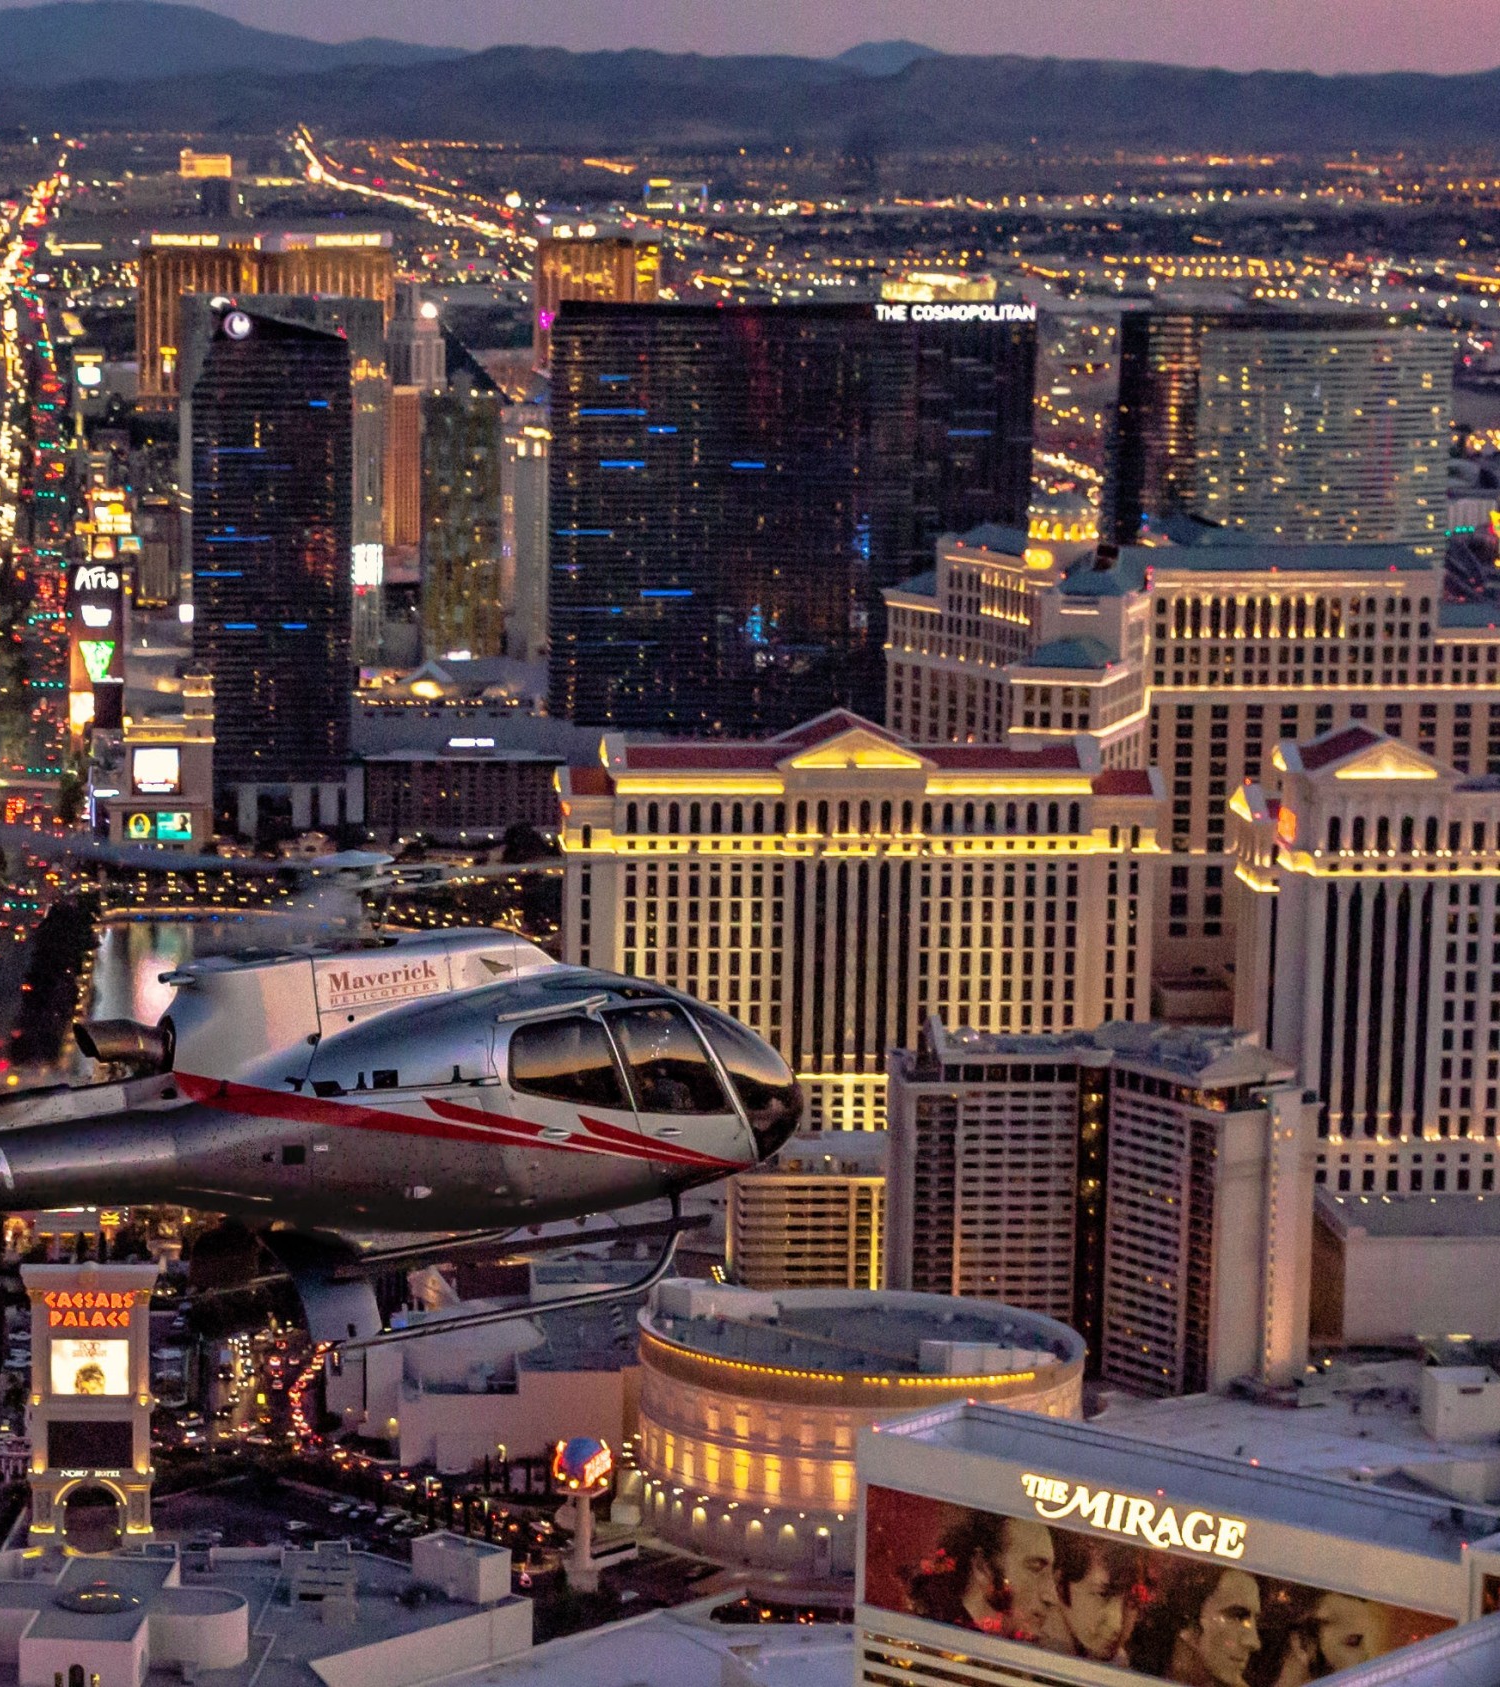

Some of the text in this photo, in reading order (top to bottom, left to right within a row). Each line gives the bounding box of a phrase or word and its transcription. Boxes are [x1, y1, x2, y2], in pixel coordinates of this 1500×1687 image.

[875, 304, 1036, 321] THE COSMOPOLITAN
[75, 566, 119, 590] Aria
[328, 960, 436, 993] Maverick
[330, 982, 440, 1006] HELICOPTERS
[44, 1291, 135, 1308] CAESARS
[49, 1310, 130, 1327] PALACE
[1021, 1473, 1248, 1560] THE MIRAGE
